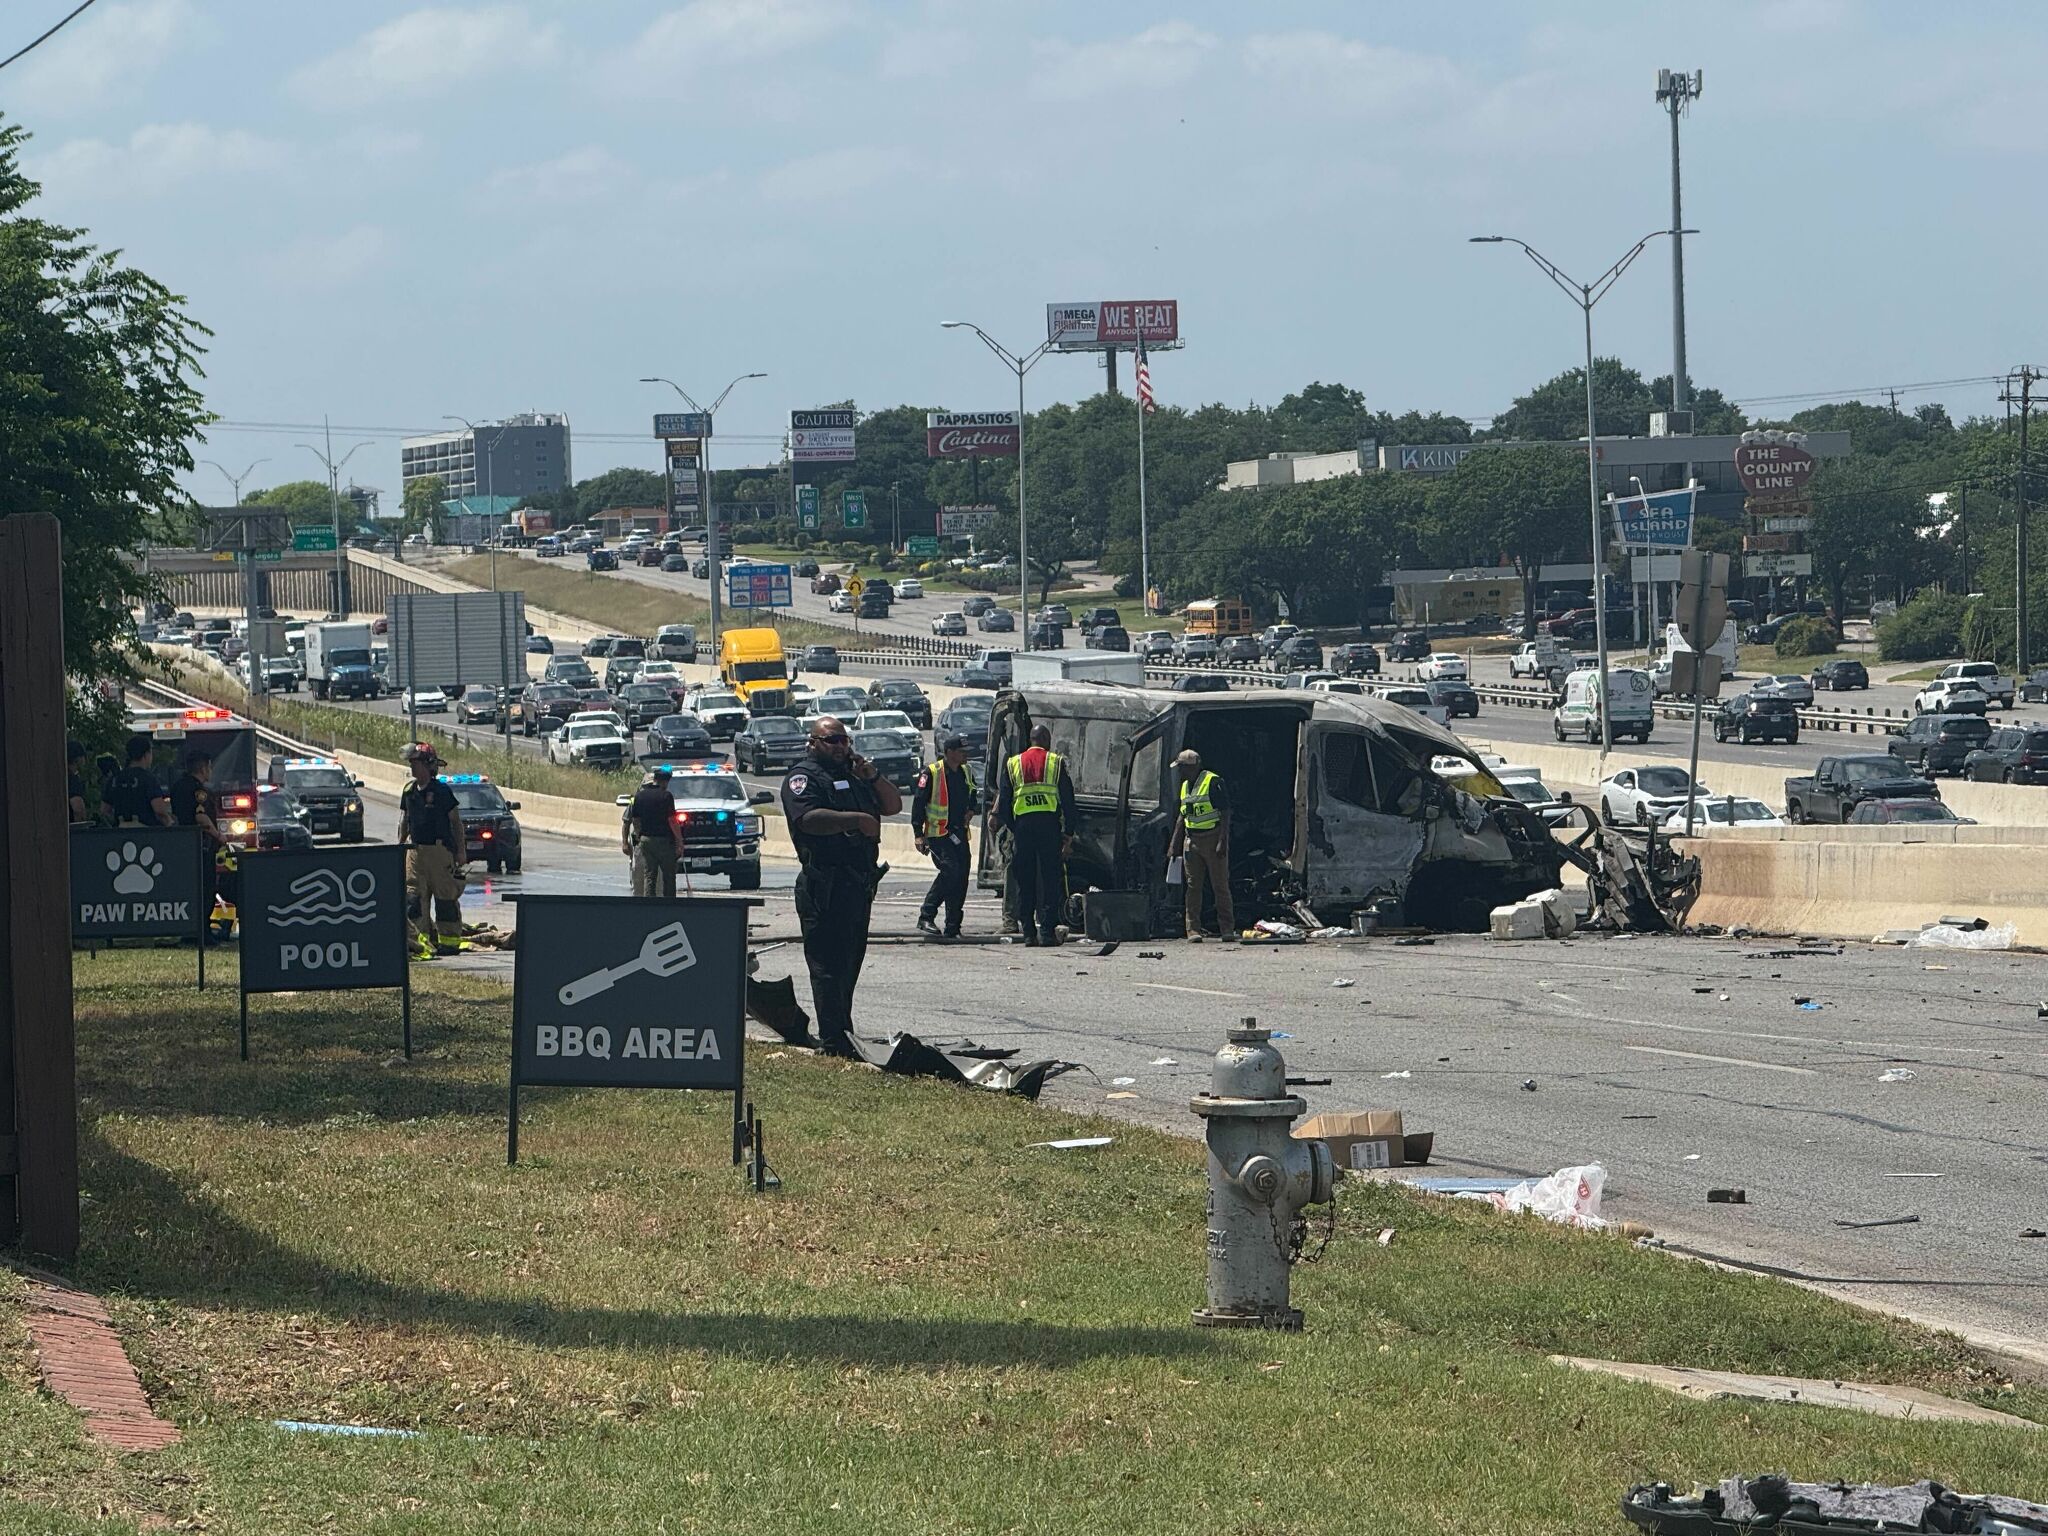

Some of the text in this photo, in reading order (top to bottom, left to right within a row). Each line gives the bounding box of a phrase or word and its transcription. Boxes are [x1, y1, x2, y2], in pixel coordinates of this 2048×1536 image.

[1064, 309, 1096, 320] MEGA
[1103, 305, 1173, 328] WE BEAT
[1053, 319, 1097, 331] FURNITURE
[1150, 327, 1173, 335] PRICE
[794, 413, 851, 426] GAUTIER
[936, 413, 1013, 426] PAPPASITOS
[938, 430, 1011, 453] Cantina
[1747, 448, 1780, 460] THE
[1743, 460, 1812, 475] COUNTY
[1755, 476, 1794, 489] LINE
[849, 505, 858, 513] 10
[1639, 507, 1674, 520] SEA
[1624, 520, 1688, 532] ISLAND
[81, 901, 190, 923] PAW PARK
[280, 942, 369, 970] POOL
[535, 1025, 721, 1061] BBQ AREA
